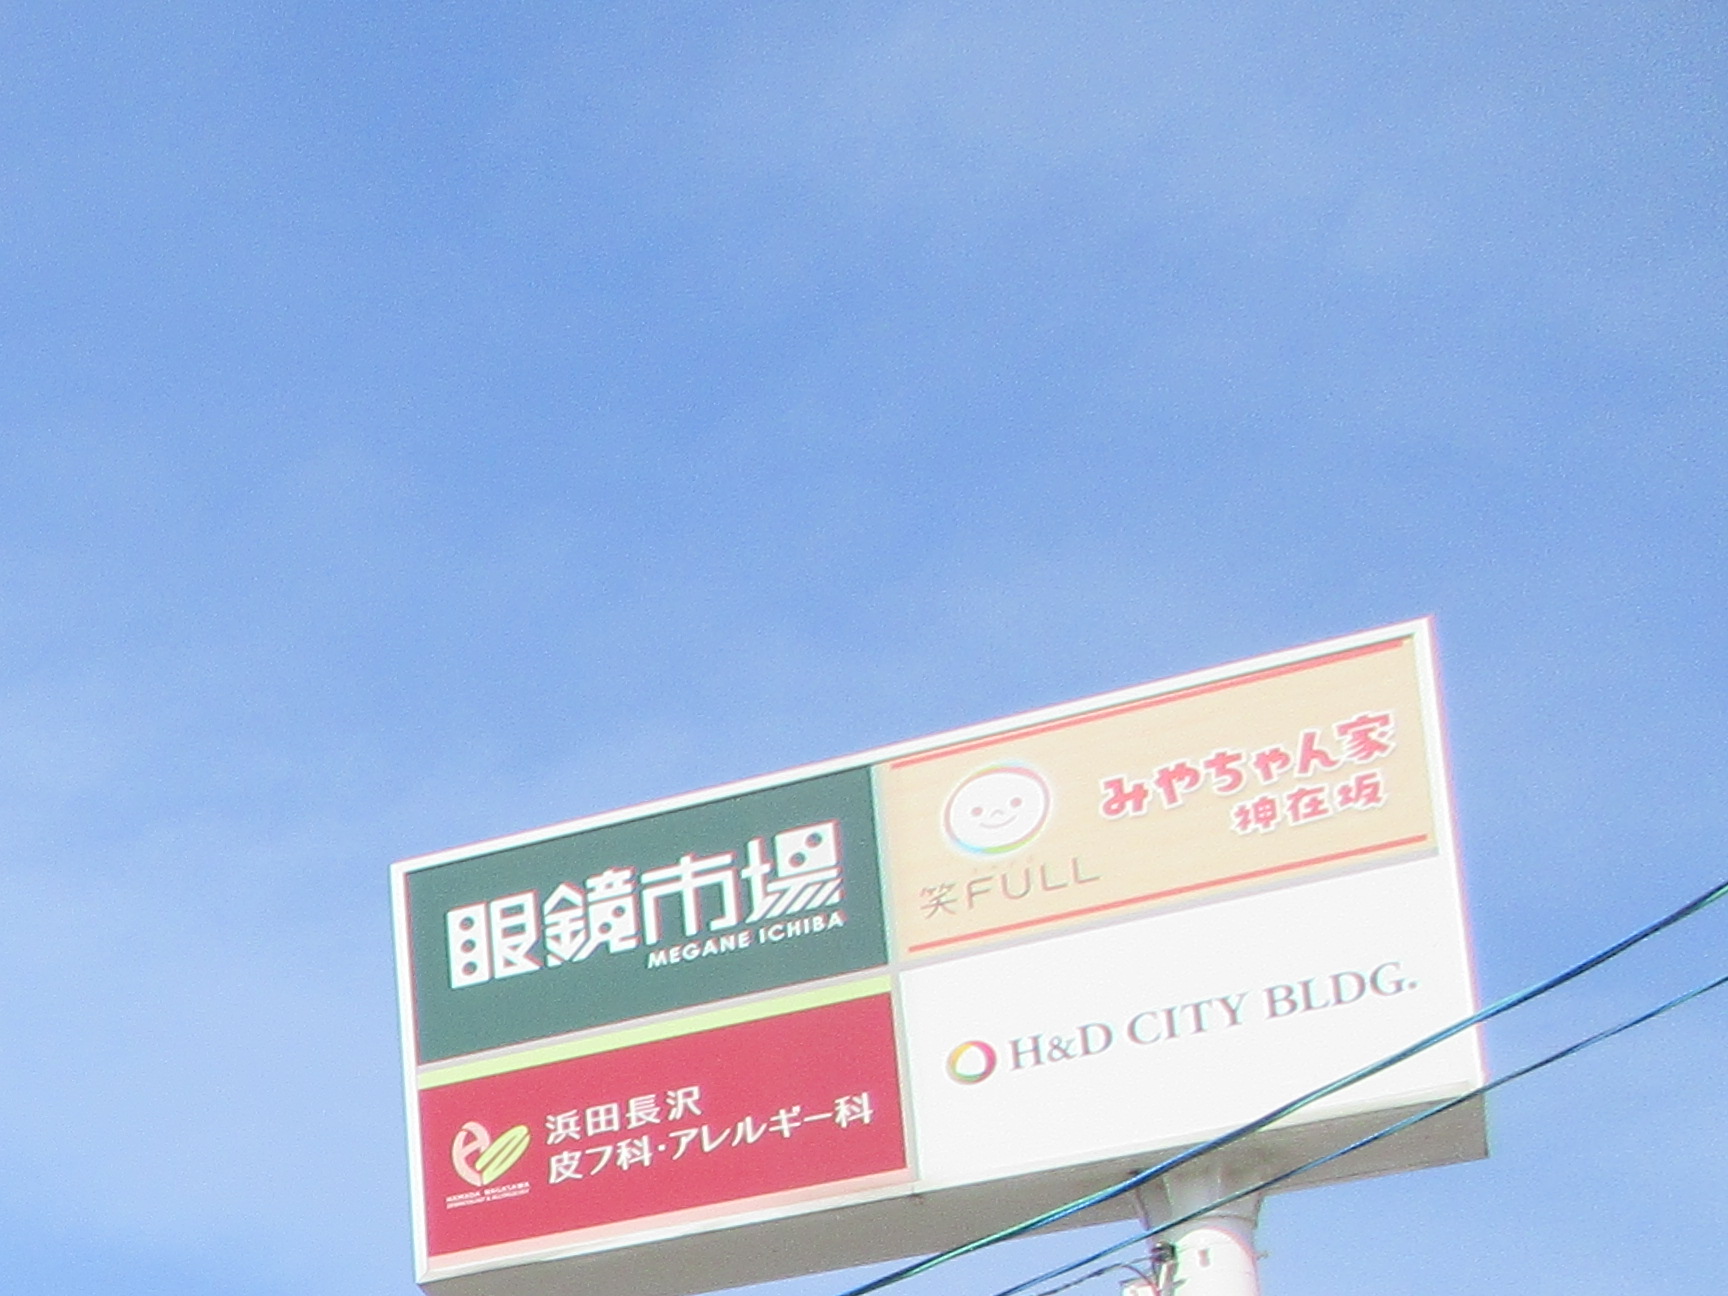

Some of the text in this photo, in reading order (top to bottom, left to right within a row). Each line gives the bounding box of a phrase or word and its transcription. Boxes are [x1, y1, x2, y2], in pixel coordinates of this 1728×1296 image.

[1099, 709, 1397, 820] みやちゃん家
[1230, 768, 1388, 836] 神在坂
[447, 820, 844, 990] 眼鏡市場
[918, 857, 1100, 919] 笑FULL
[647, 910, 844, 969] MEGANE ICHIBA
[1008, 959, 1418, 1073] H&D CITY BLDG.
[545, 1085, 703, 1144] 浜田長沢
[547, 1091, 874, 1184] 皮フ科・アレルギー科
